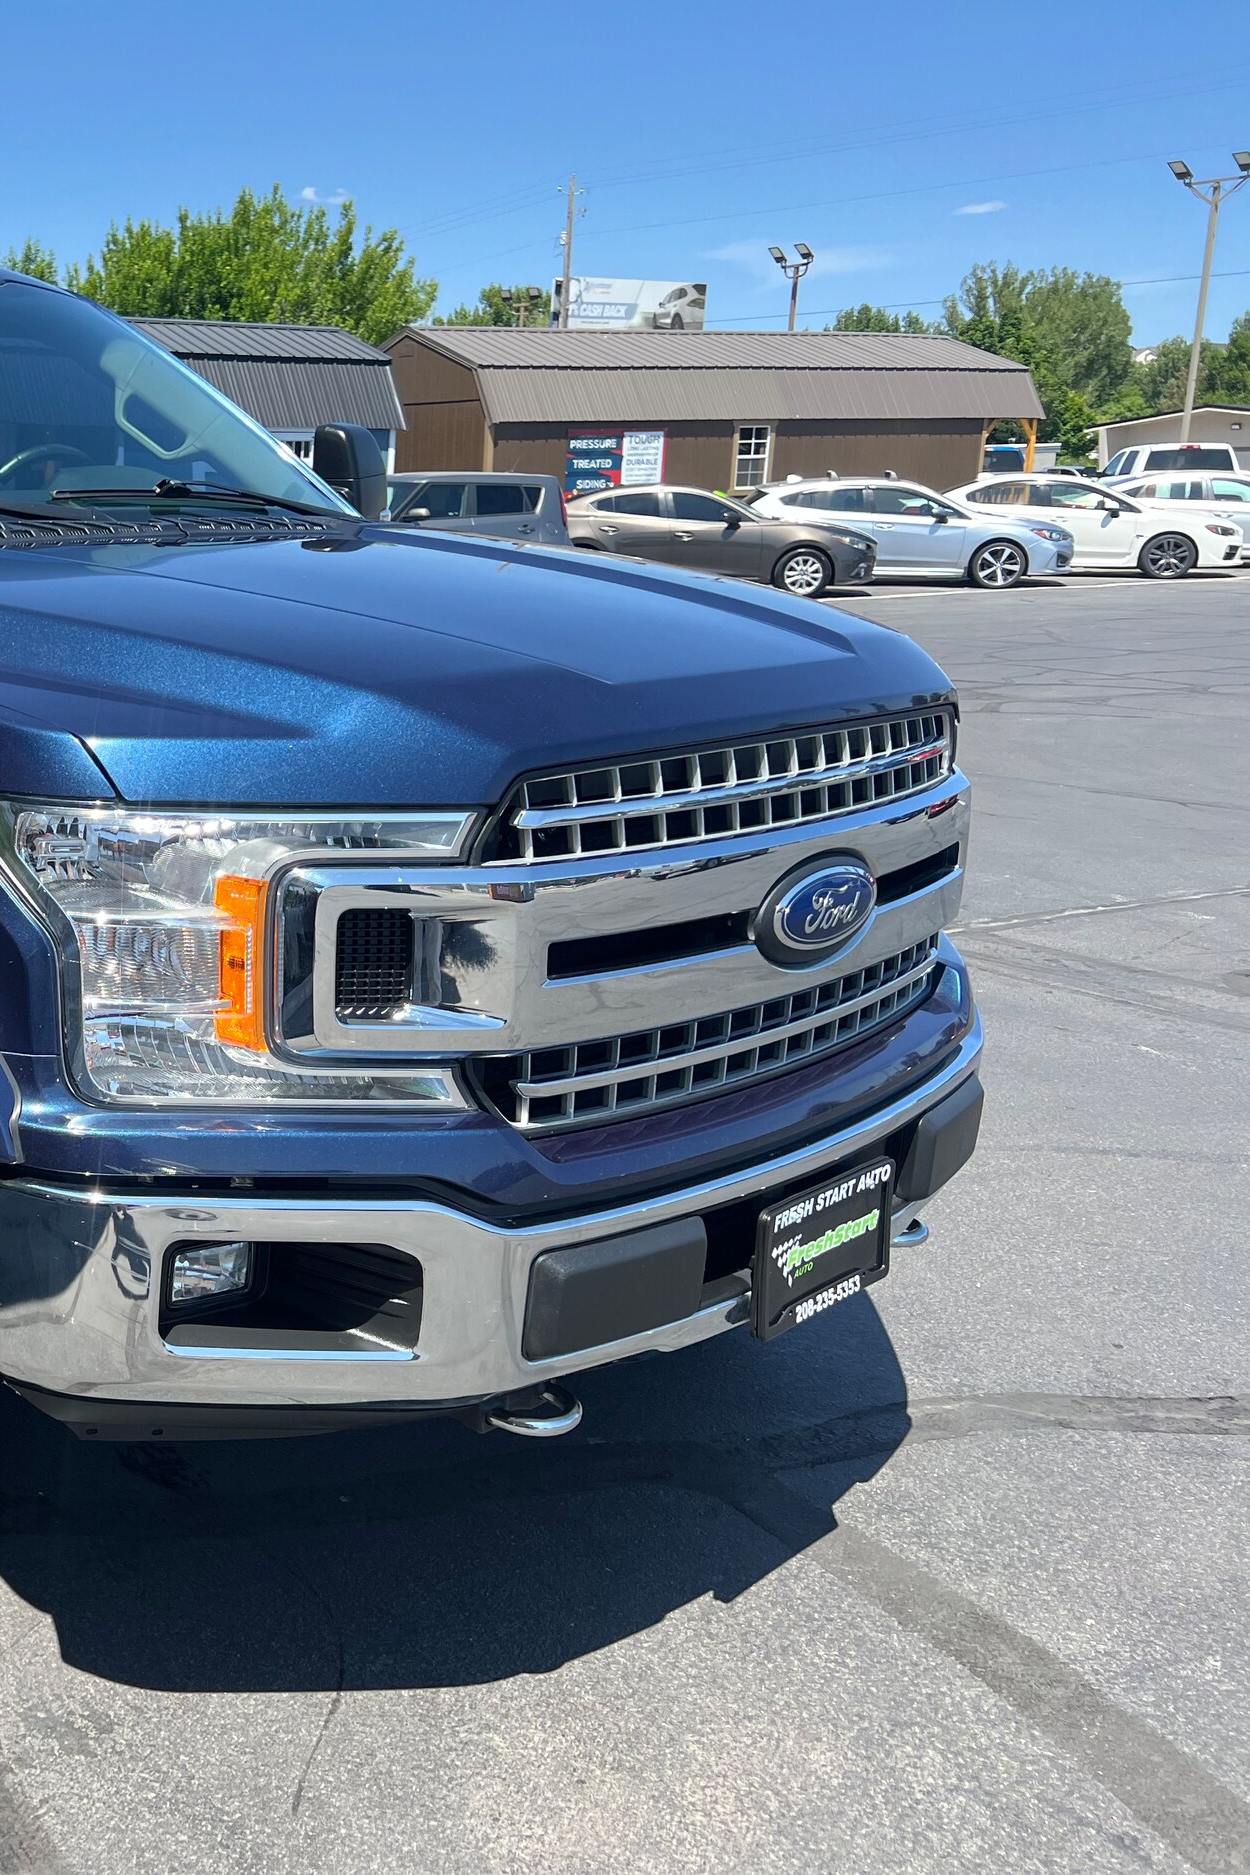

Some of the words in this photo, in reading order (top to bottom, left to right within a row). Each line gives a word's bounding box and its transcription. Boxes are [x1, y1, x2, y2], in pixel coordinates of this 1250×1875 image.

[579, 303, 603, 317] CASH
[603, 304, 628, 318] BACK
[570, 438, 617, 449] PRESSURE
[628, 434, 661, 445] TOUGH
[572, 459, 612, 469] TREATED
[626, 458, 658, 466] DURABLE
[576, 479, 606, 489] SIDING
[805, 883, 860, 934] Ford
[774, 1198, 814, 1233] FRESH
[816, 1180, 856, 1212] START
[857, 1164, 891, 1193] AUTO
[793, 1261, 814, 1279] AUTO
[795, 1274, 861, 1323] 208-235-5353
